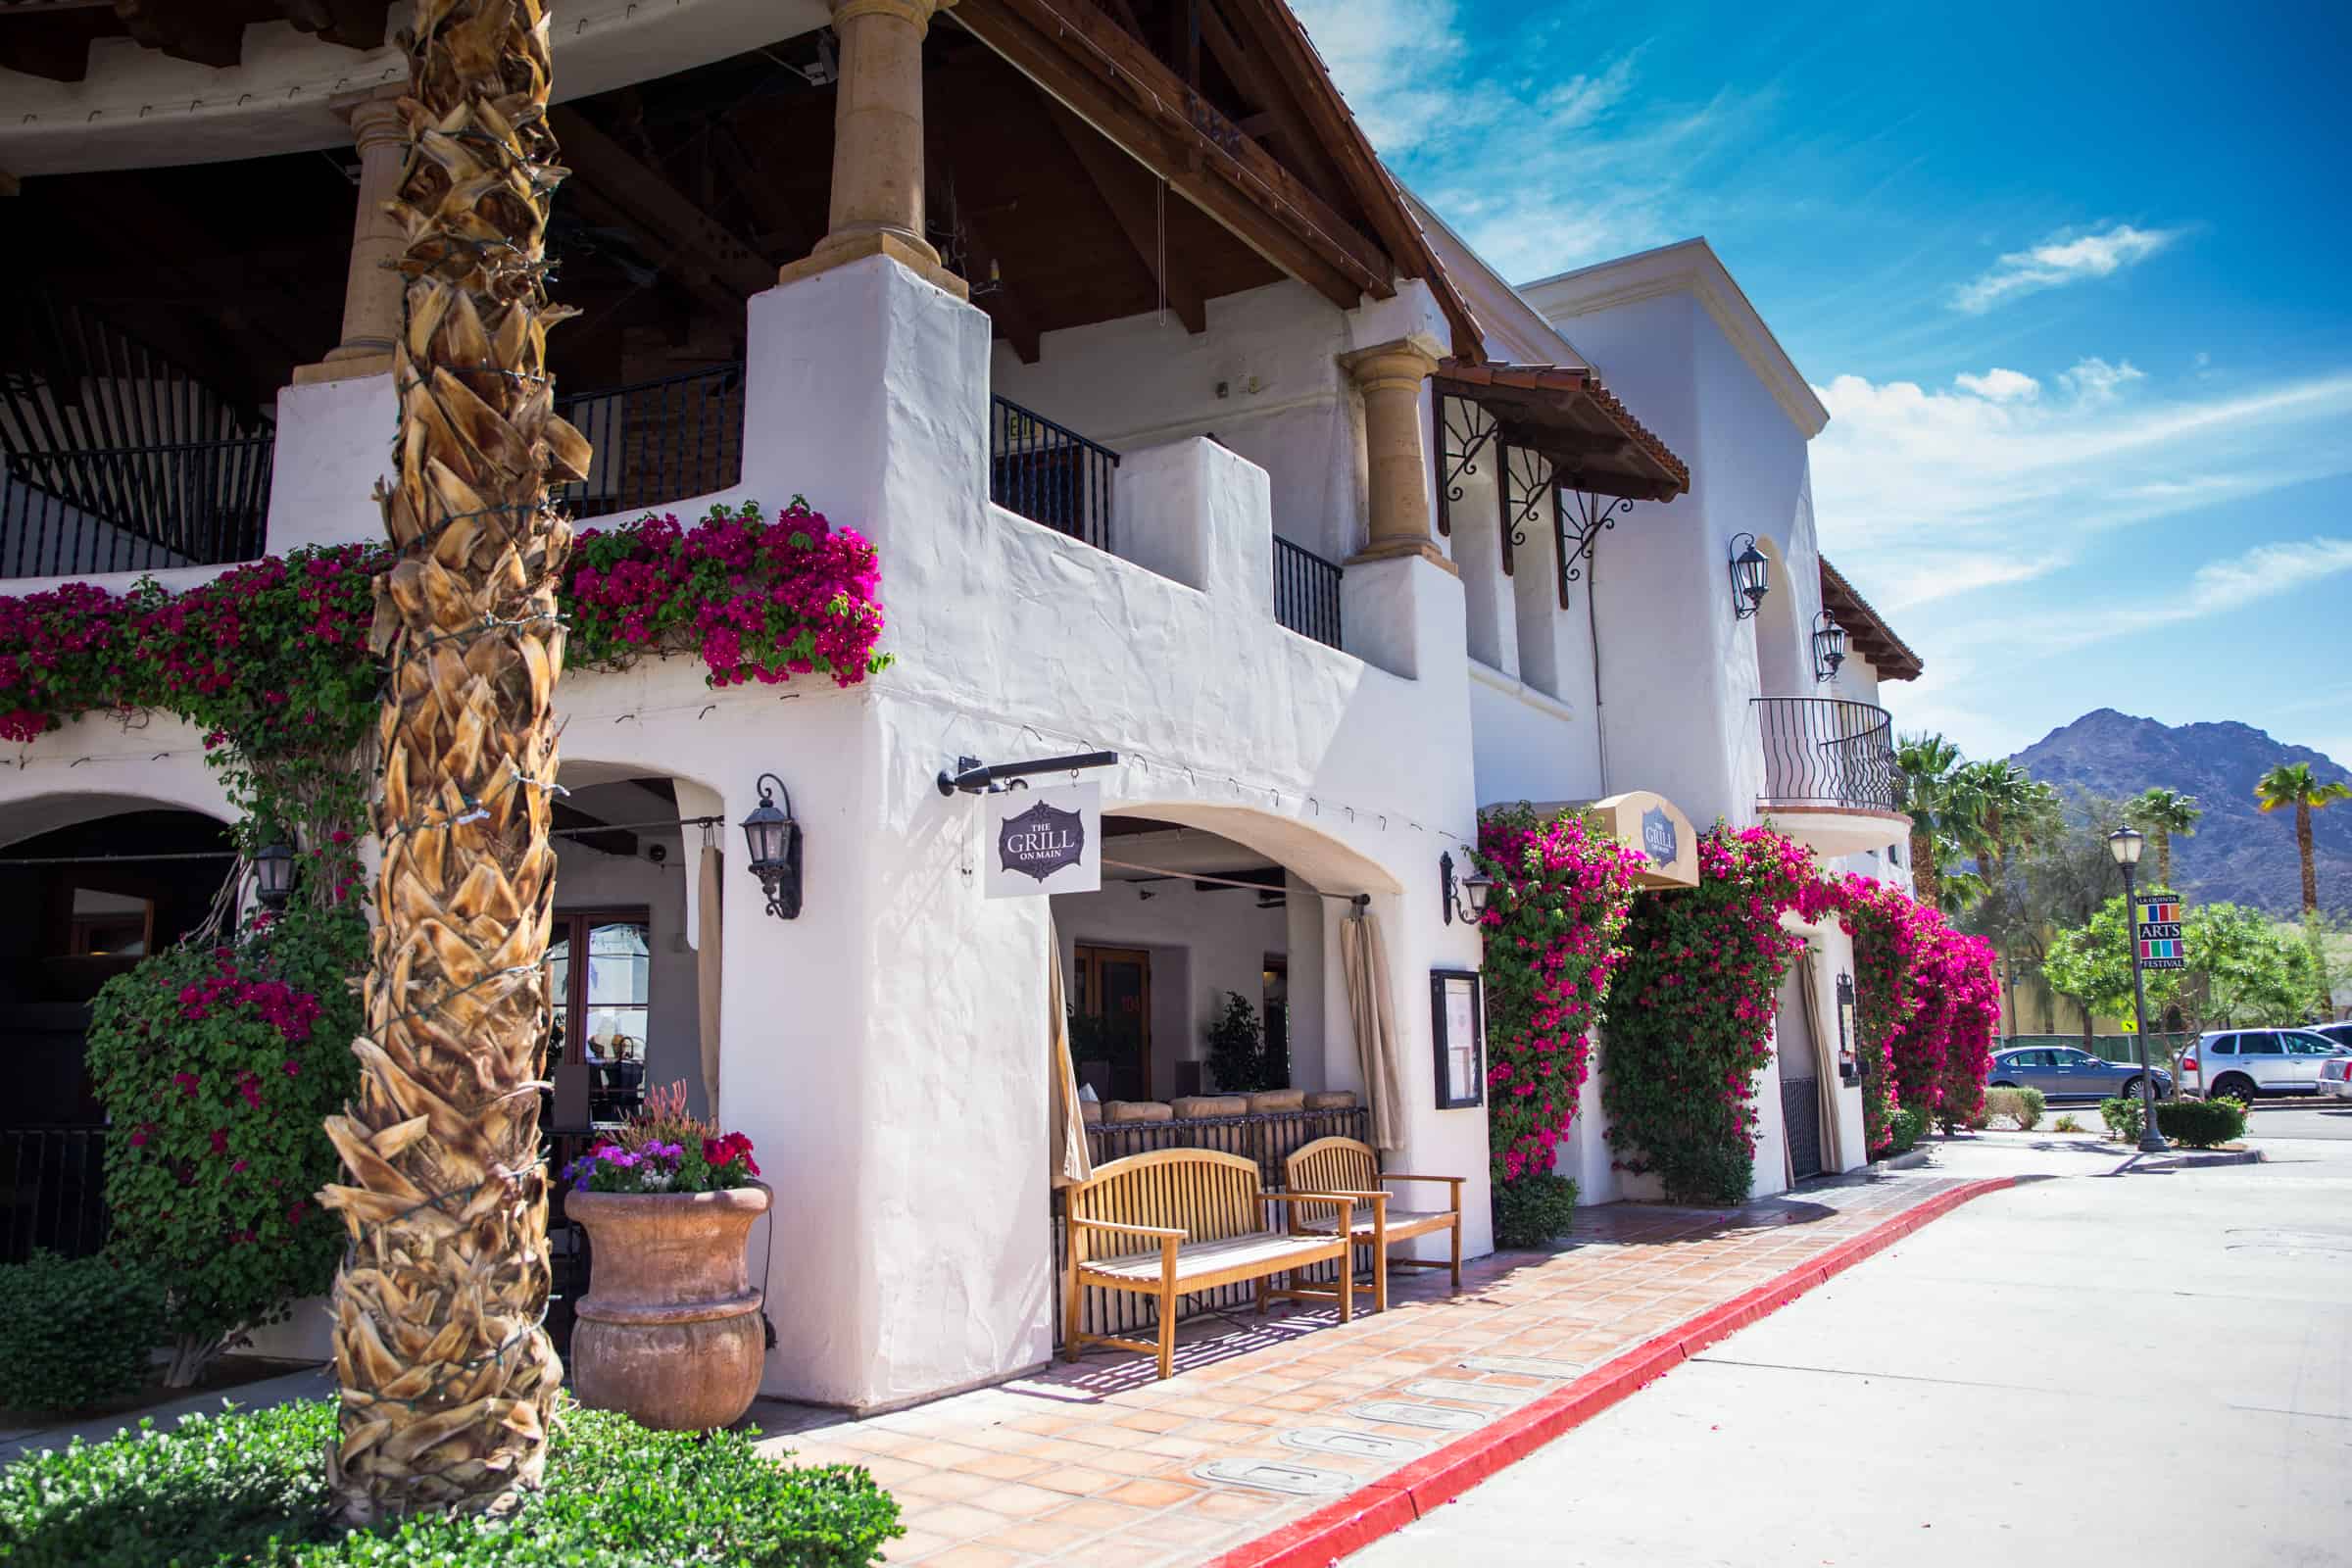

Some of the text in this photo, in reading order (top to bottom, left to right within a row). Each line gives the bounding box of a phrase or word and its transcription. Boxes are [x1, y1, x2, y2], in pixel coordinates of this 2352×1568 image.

[1032, 823, 1051, 832] THE
[1007, 830, 1075, 854] GRILL
[1646, 827, 1674, 849] GRILL
[1036, 850, 1061, 858] MAIN
[2141, 924, 2180, 937] ARTS
